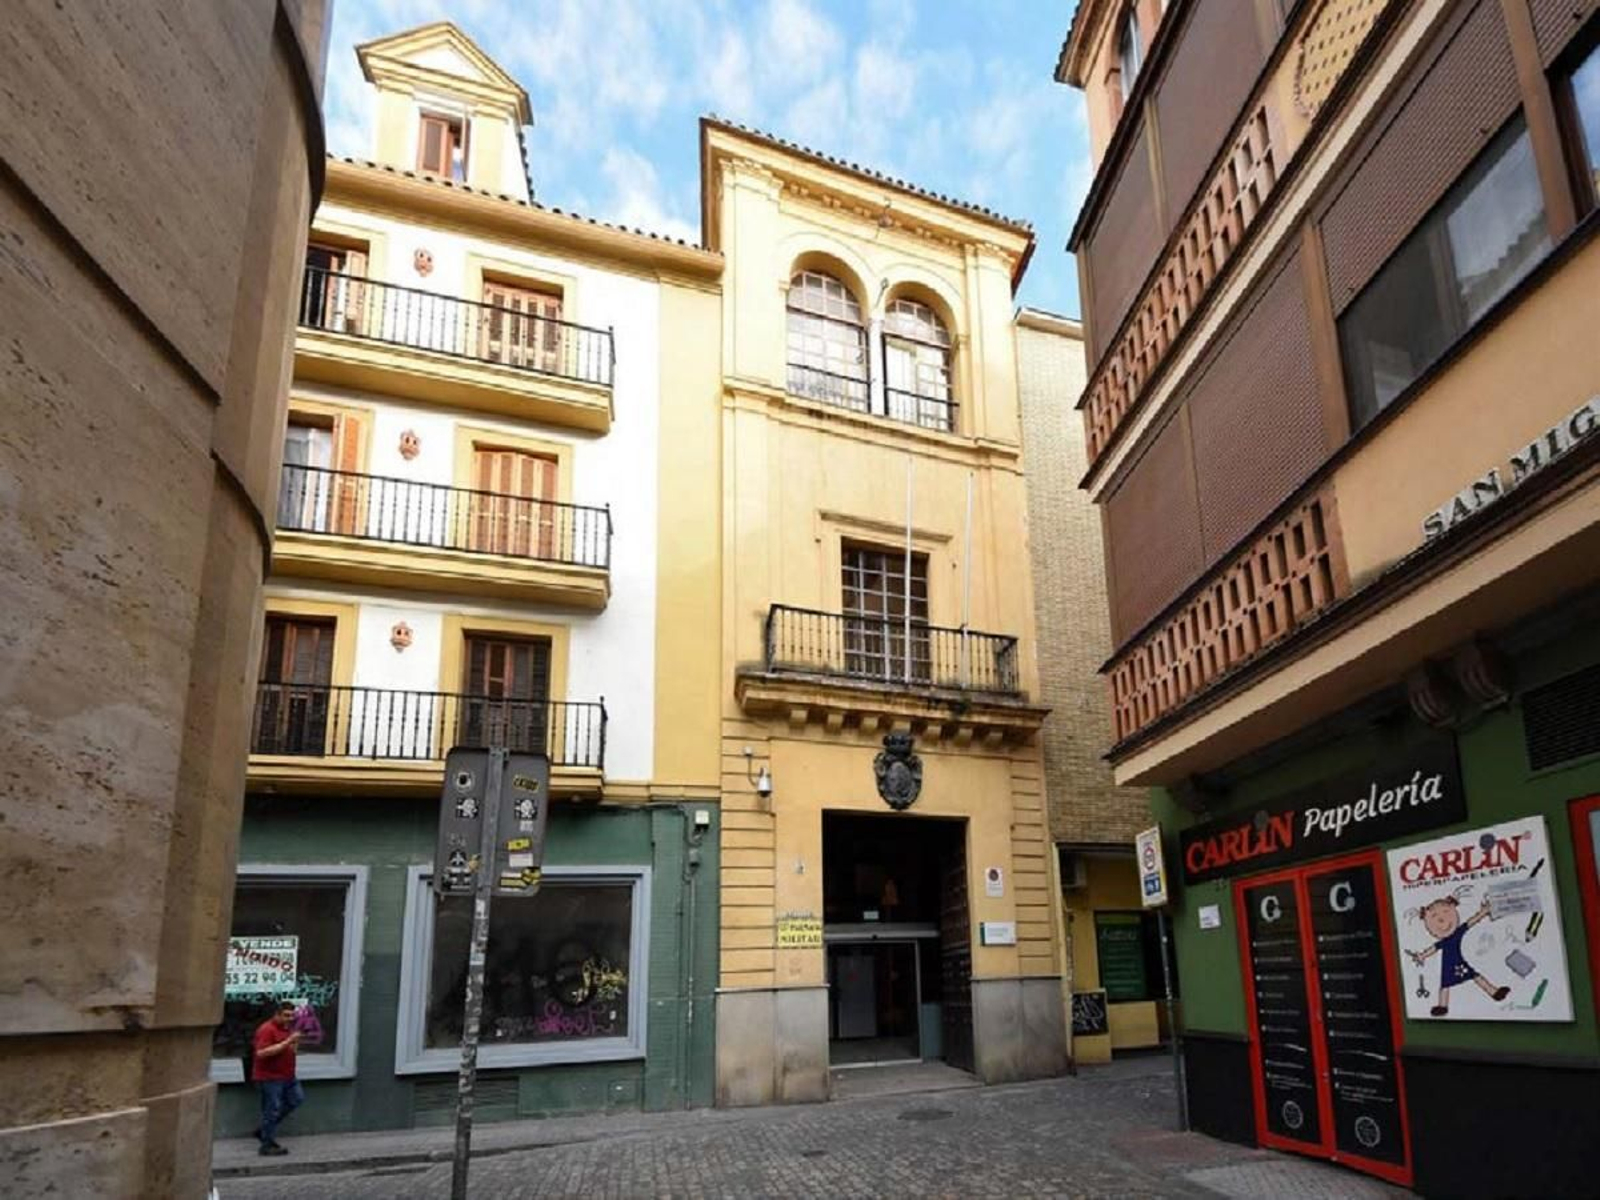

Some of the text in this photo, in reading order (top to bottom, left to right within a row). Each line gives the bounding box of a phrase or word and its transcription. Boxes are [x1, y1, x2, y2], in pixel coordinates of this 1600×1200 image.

[1423, 467, 1504, 540] SAN
[1303, 770, 1443, 838] Papelería
[240, 939, 293, 949] VENDE
[244, 972, 258, 985] 22
